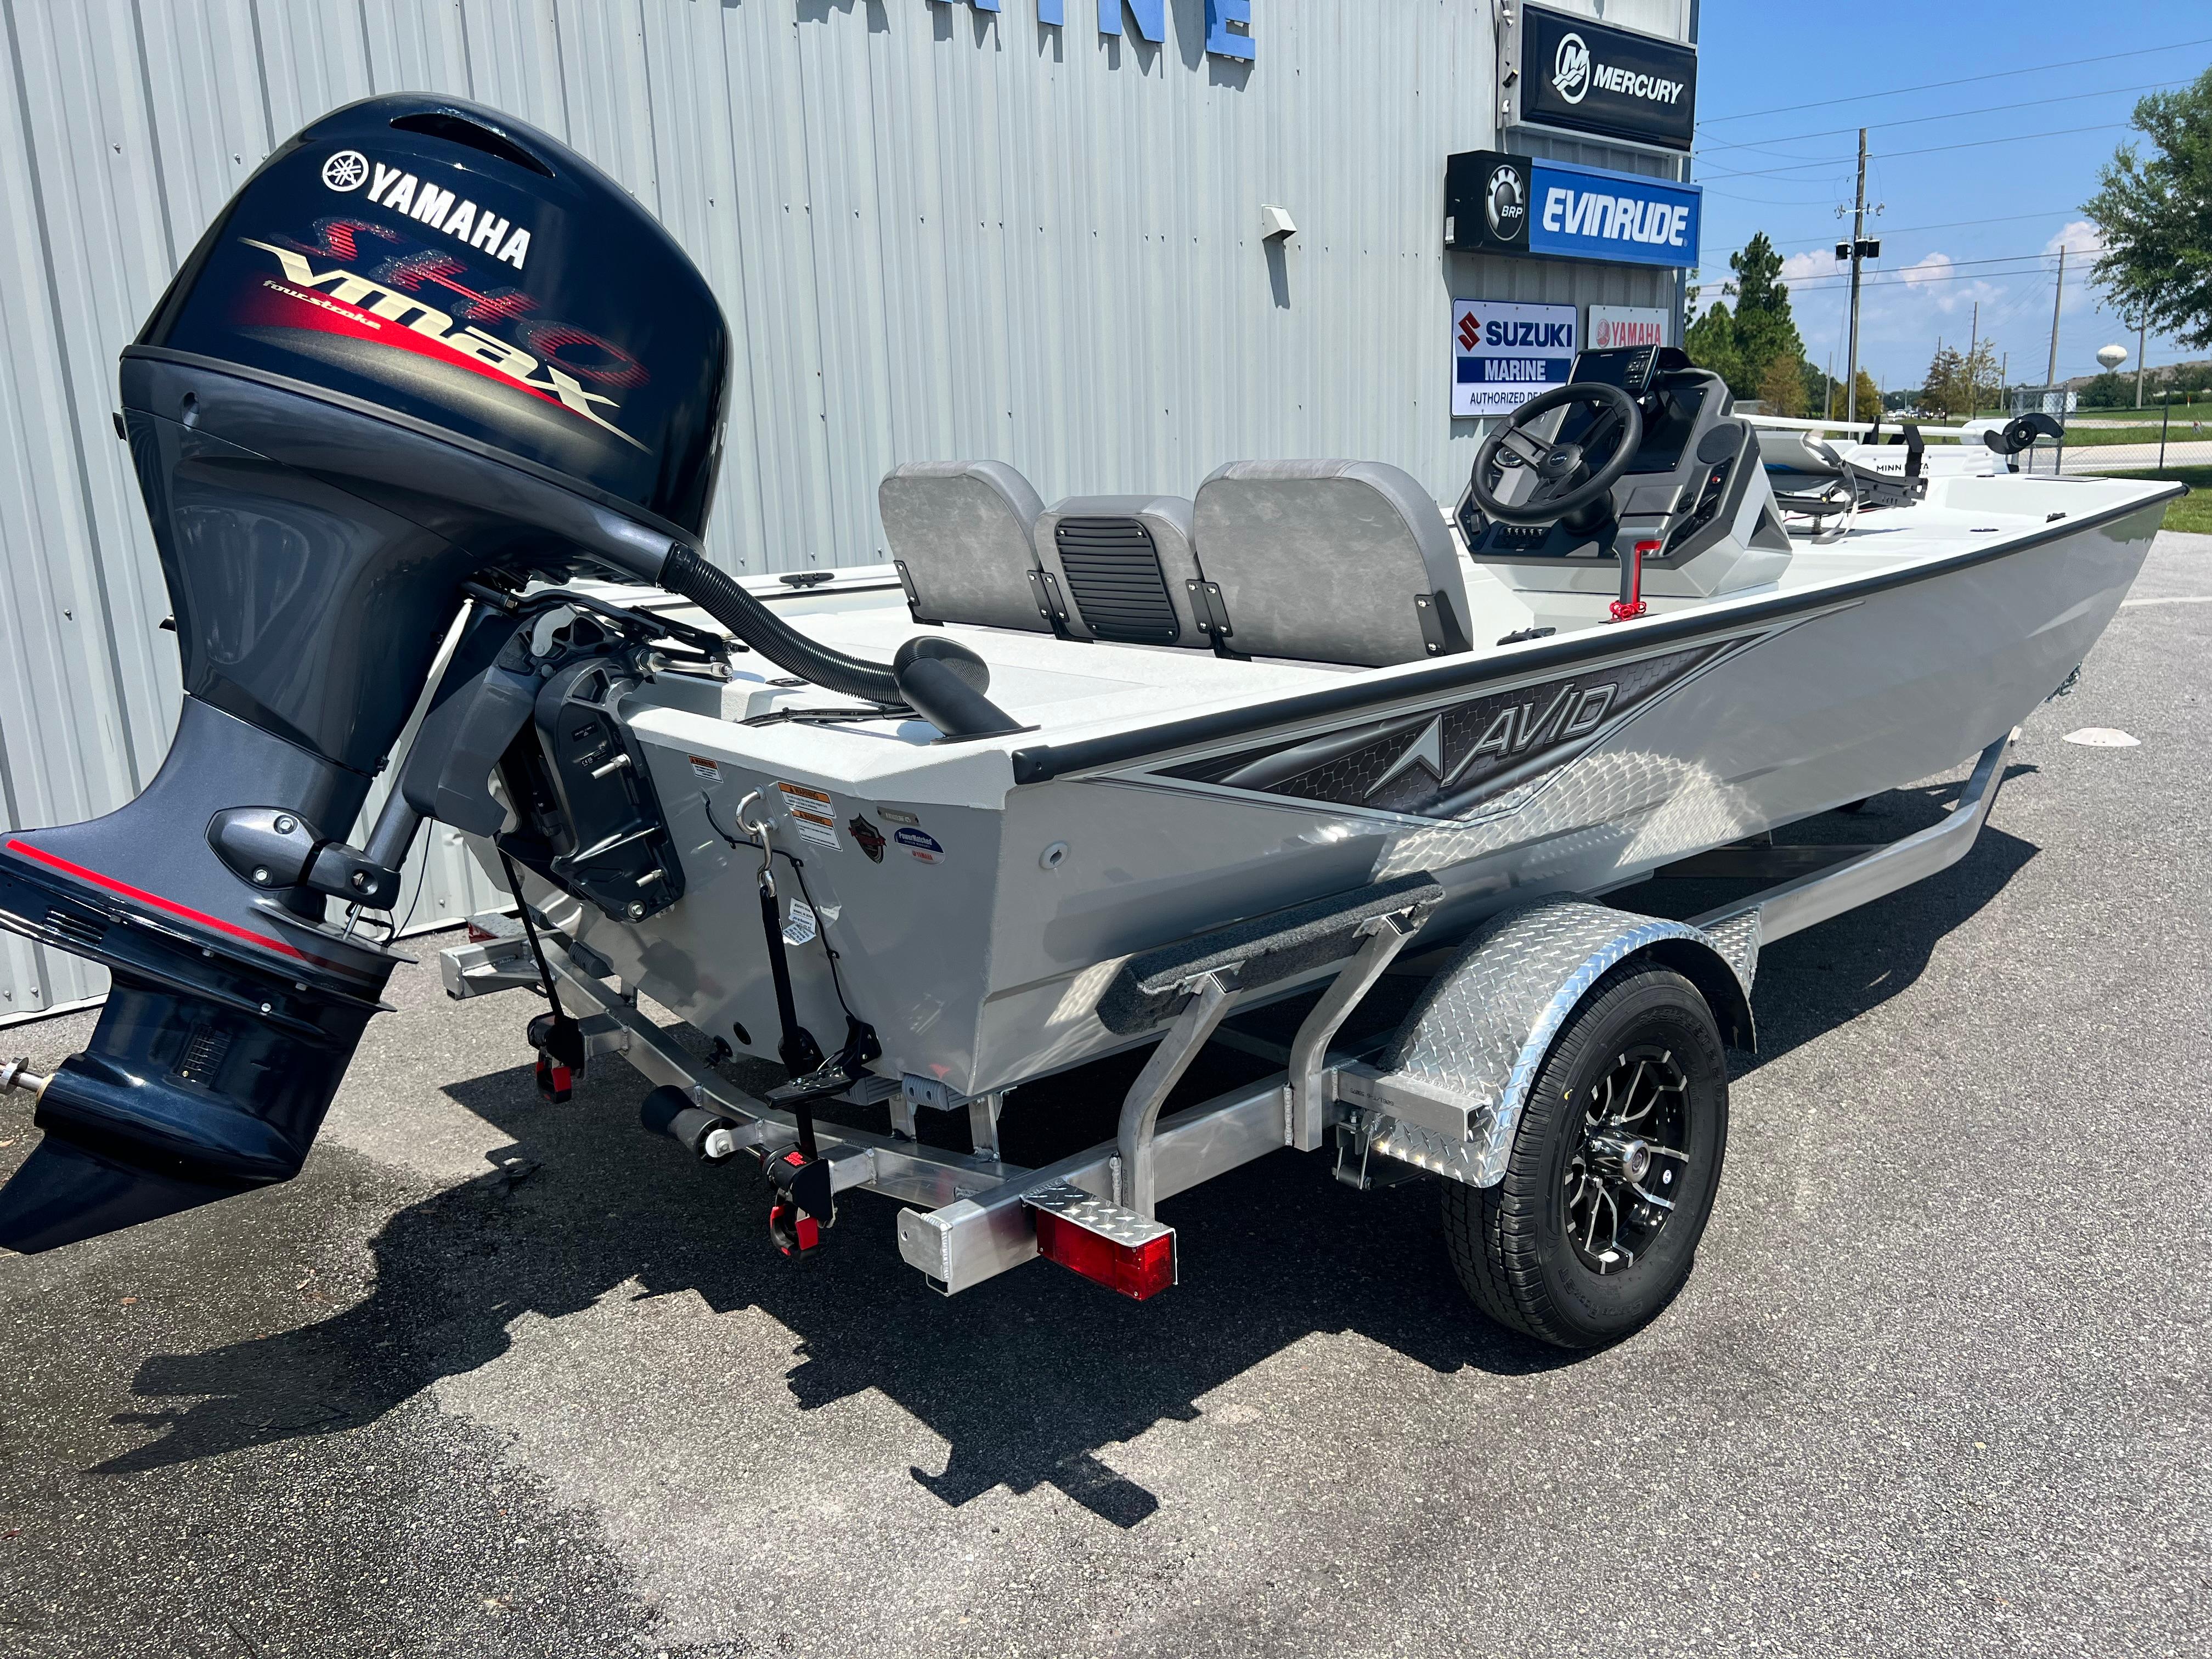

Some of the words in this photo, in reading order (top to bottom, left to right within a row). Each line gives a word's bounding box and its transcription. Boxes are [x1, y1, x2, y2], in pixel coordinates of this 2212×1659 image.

[1593, 64, 1684, 105] MERCURY
[367, 162, 531, 270] YAMAHA
[1501, 205, 1523, 218] BRP
[1542, 187, 1689, 246] EVINRUDE
[1486, 320, 1572, 347] SUZUKI
[1612, 321, 1661, 347] YAMAHA
[1485, 360, 1546, 381] MARINE
[1470, 392, 1525, 404] AUTHORIZED
[1440, 682, 1619, 788] AVID
